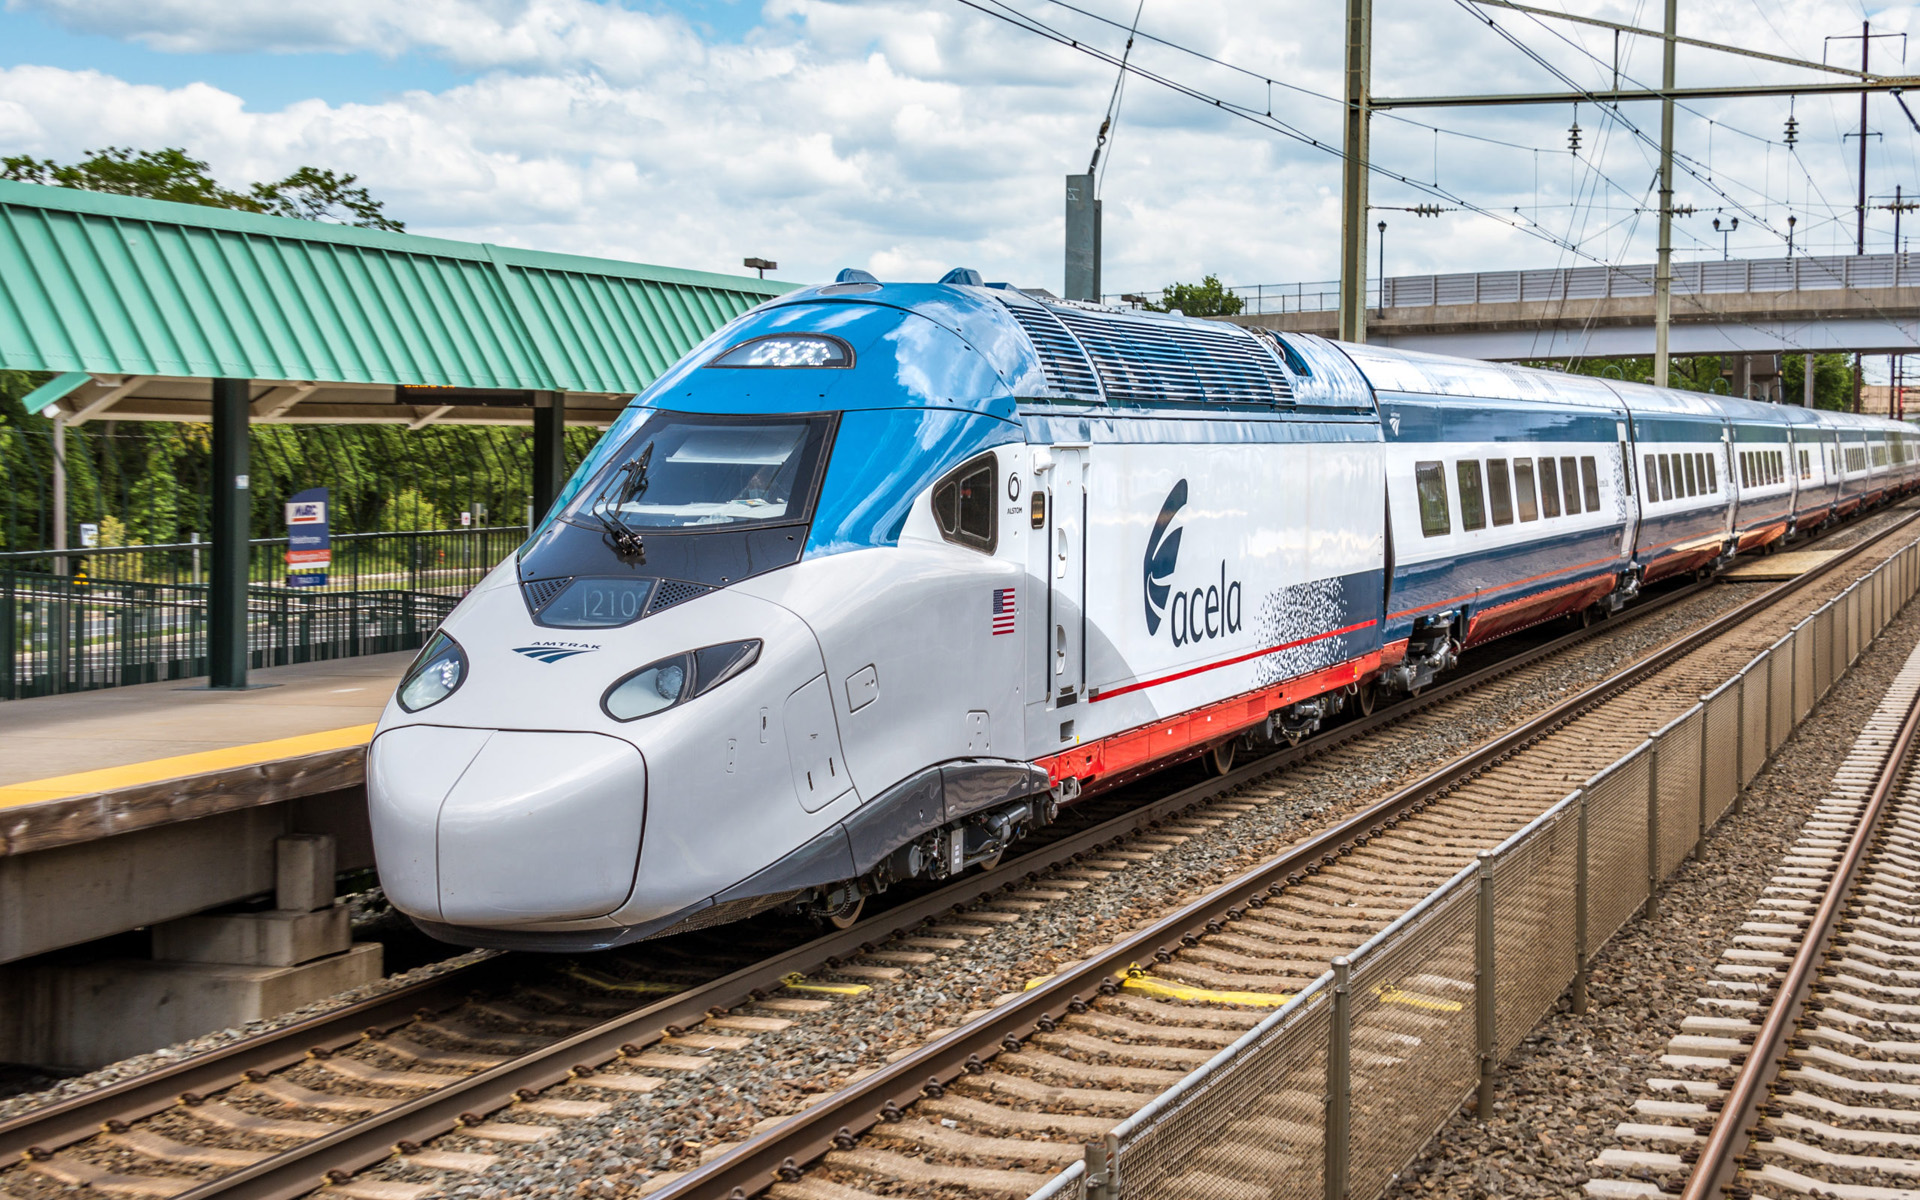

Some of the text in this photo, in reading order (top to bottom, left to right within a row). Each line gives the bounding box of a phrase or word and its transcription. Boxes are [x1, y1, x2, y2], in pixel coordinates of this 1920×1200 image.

[1007, 506, 1023, 515] ALSTOM
[1171, 558, 1242, 648] acela
[530, 641, 602, 650] AMTRAK
